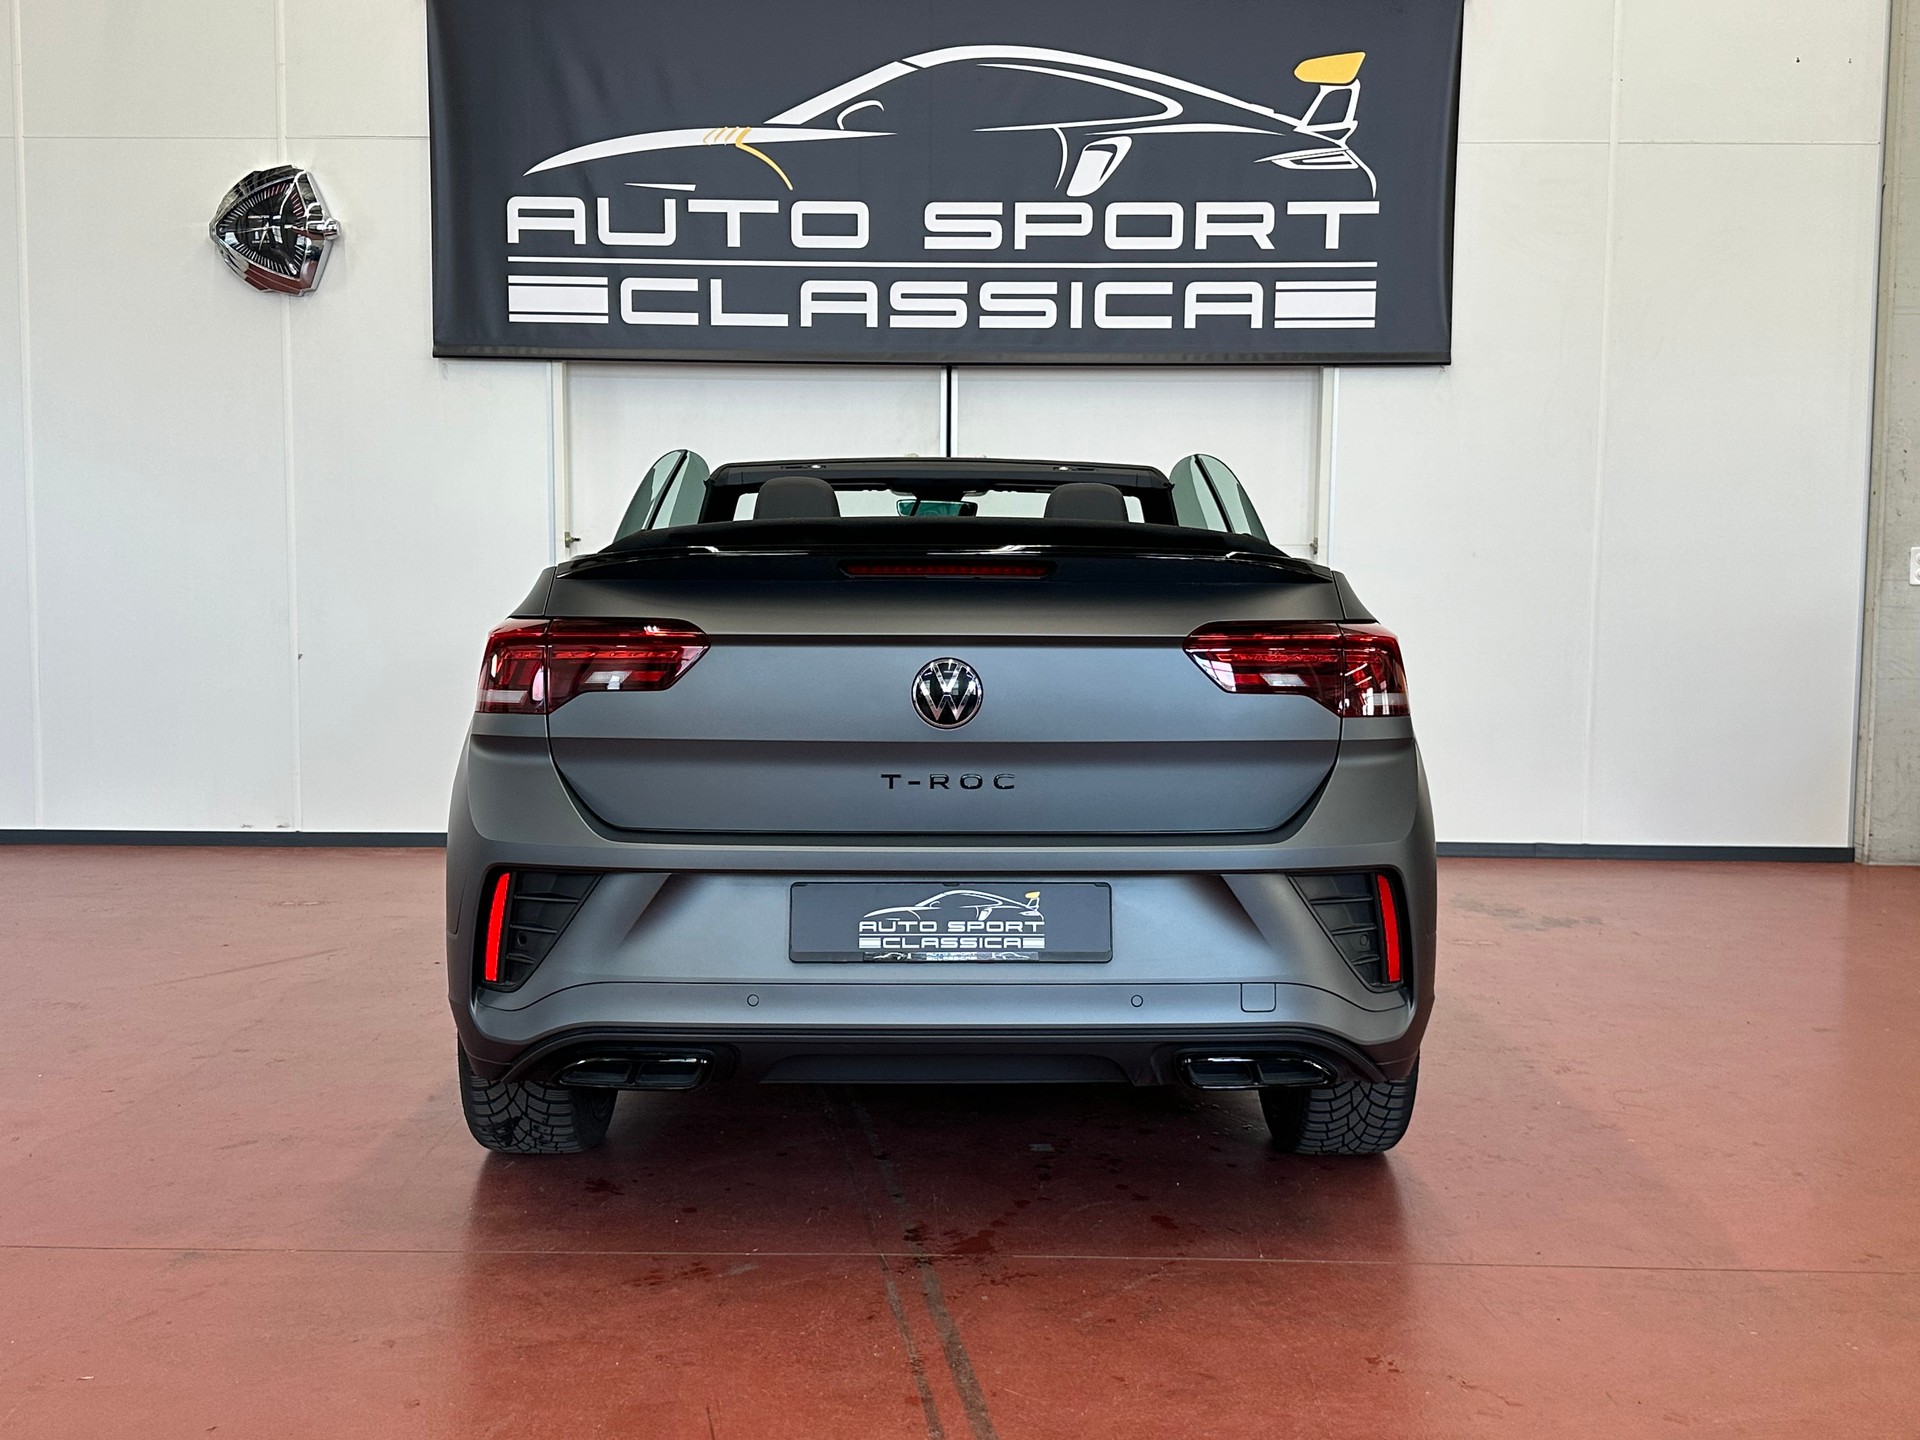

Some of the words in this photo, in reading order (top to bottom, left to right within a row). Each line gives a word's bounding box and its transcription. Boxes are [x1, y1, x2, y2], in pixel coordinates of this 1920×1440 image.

[506, 195, 870, 249] AUTO
[923, 200, 1380, 251] SPORT
[619, 276, 1264, 329] CLASSICA
[880, 773, 1015, 790] T-ROC
[858, 921, 938, 933] AUTO
[947, 921, 1045, 933] SPORT
[882, 937, 1022, 949] CLASSICA
